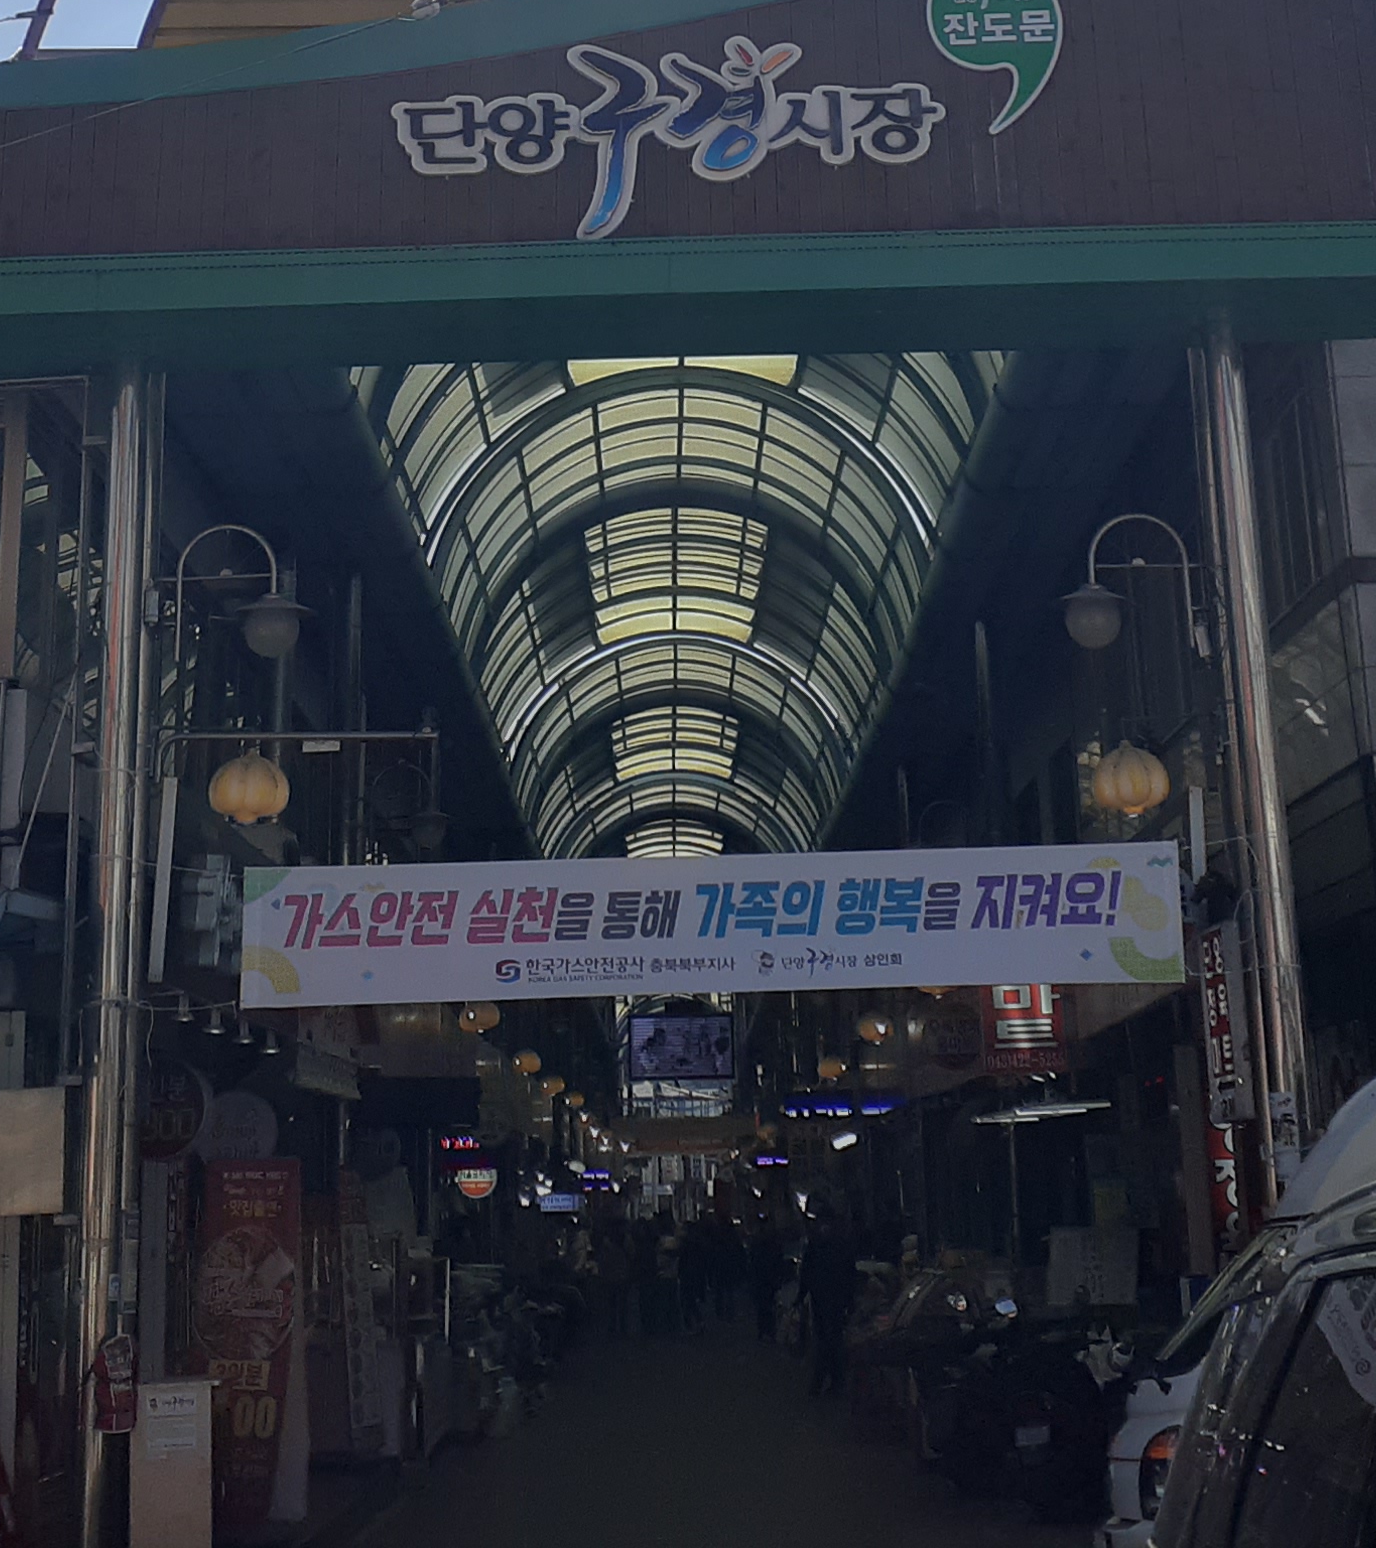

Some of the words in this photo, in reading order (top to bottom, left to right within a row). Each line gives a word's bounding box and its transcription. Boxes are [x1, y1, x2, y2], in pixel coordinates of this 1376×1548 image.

[943, 10, 1055, 45] 잔도문
[283, 888, 460, 950] 가스안전
[466, 886, 595, 946] 실천을
[599, 889, 682, 940] 통해
[696, 879, 826, 939] 가족의
[835, 876, 962, 936] 행복을
[970, 869, 1122, 930] 지켜요!
[526, 956, 644, 977] 한국가스안전공사
[650, 957, 736, 974] 충북북부지사
[864, 952, 902, 967] 상인회
